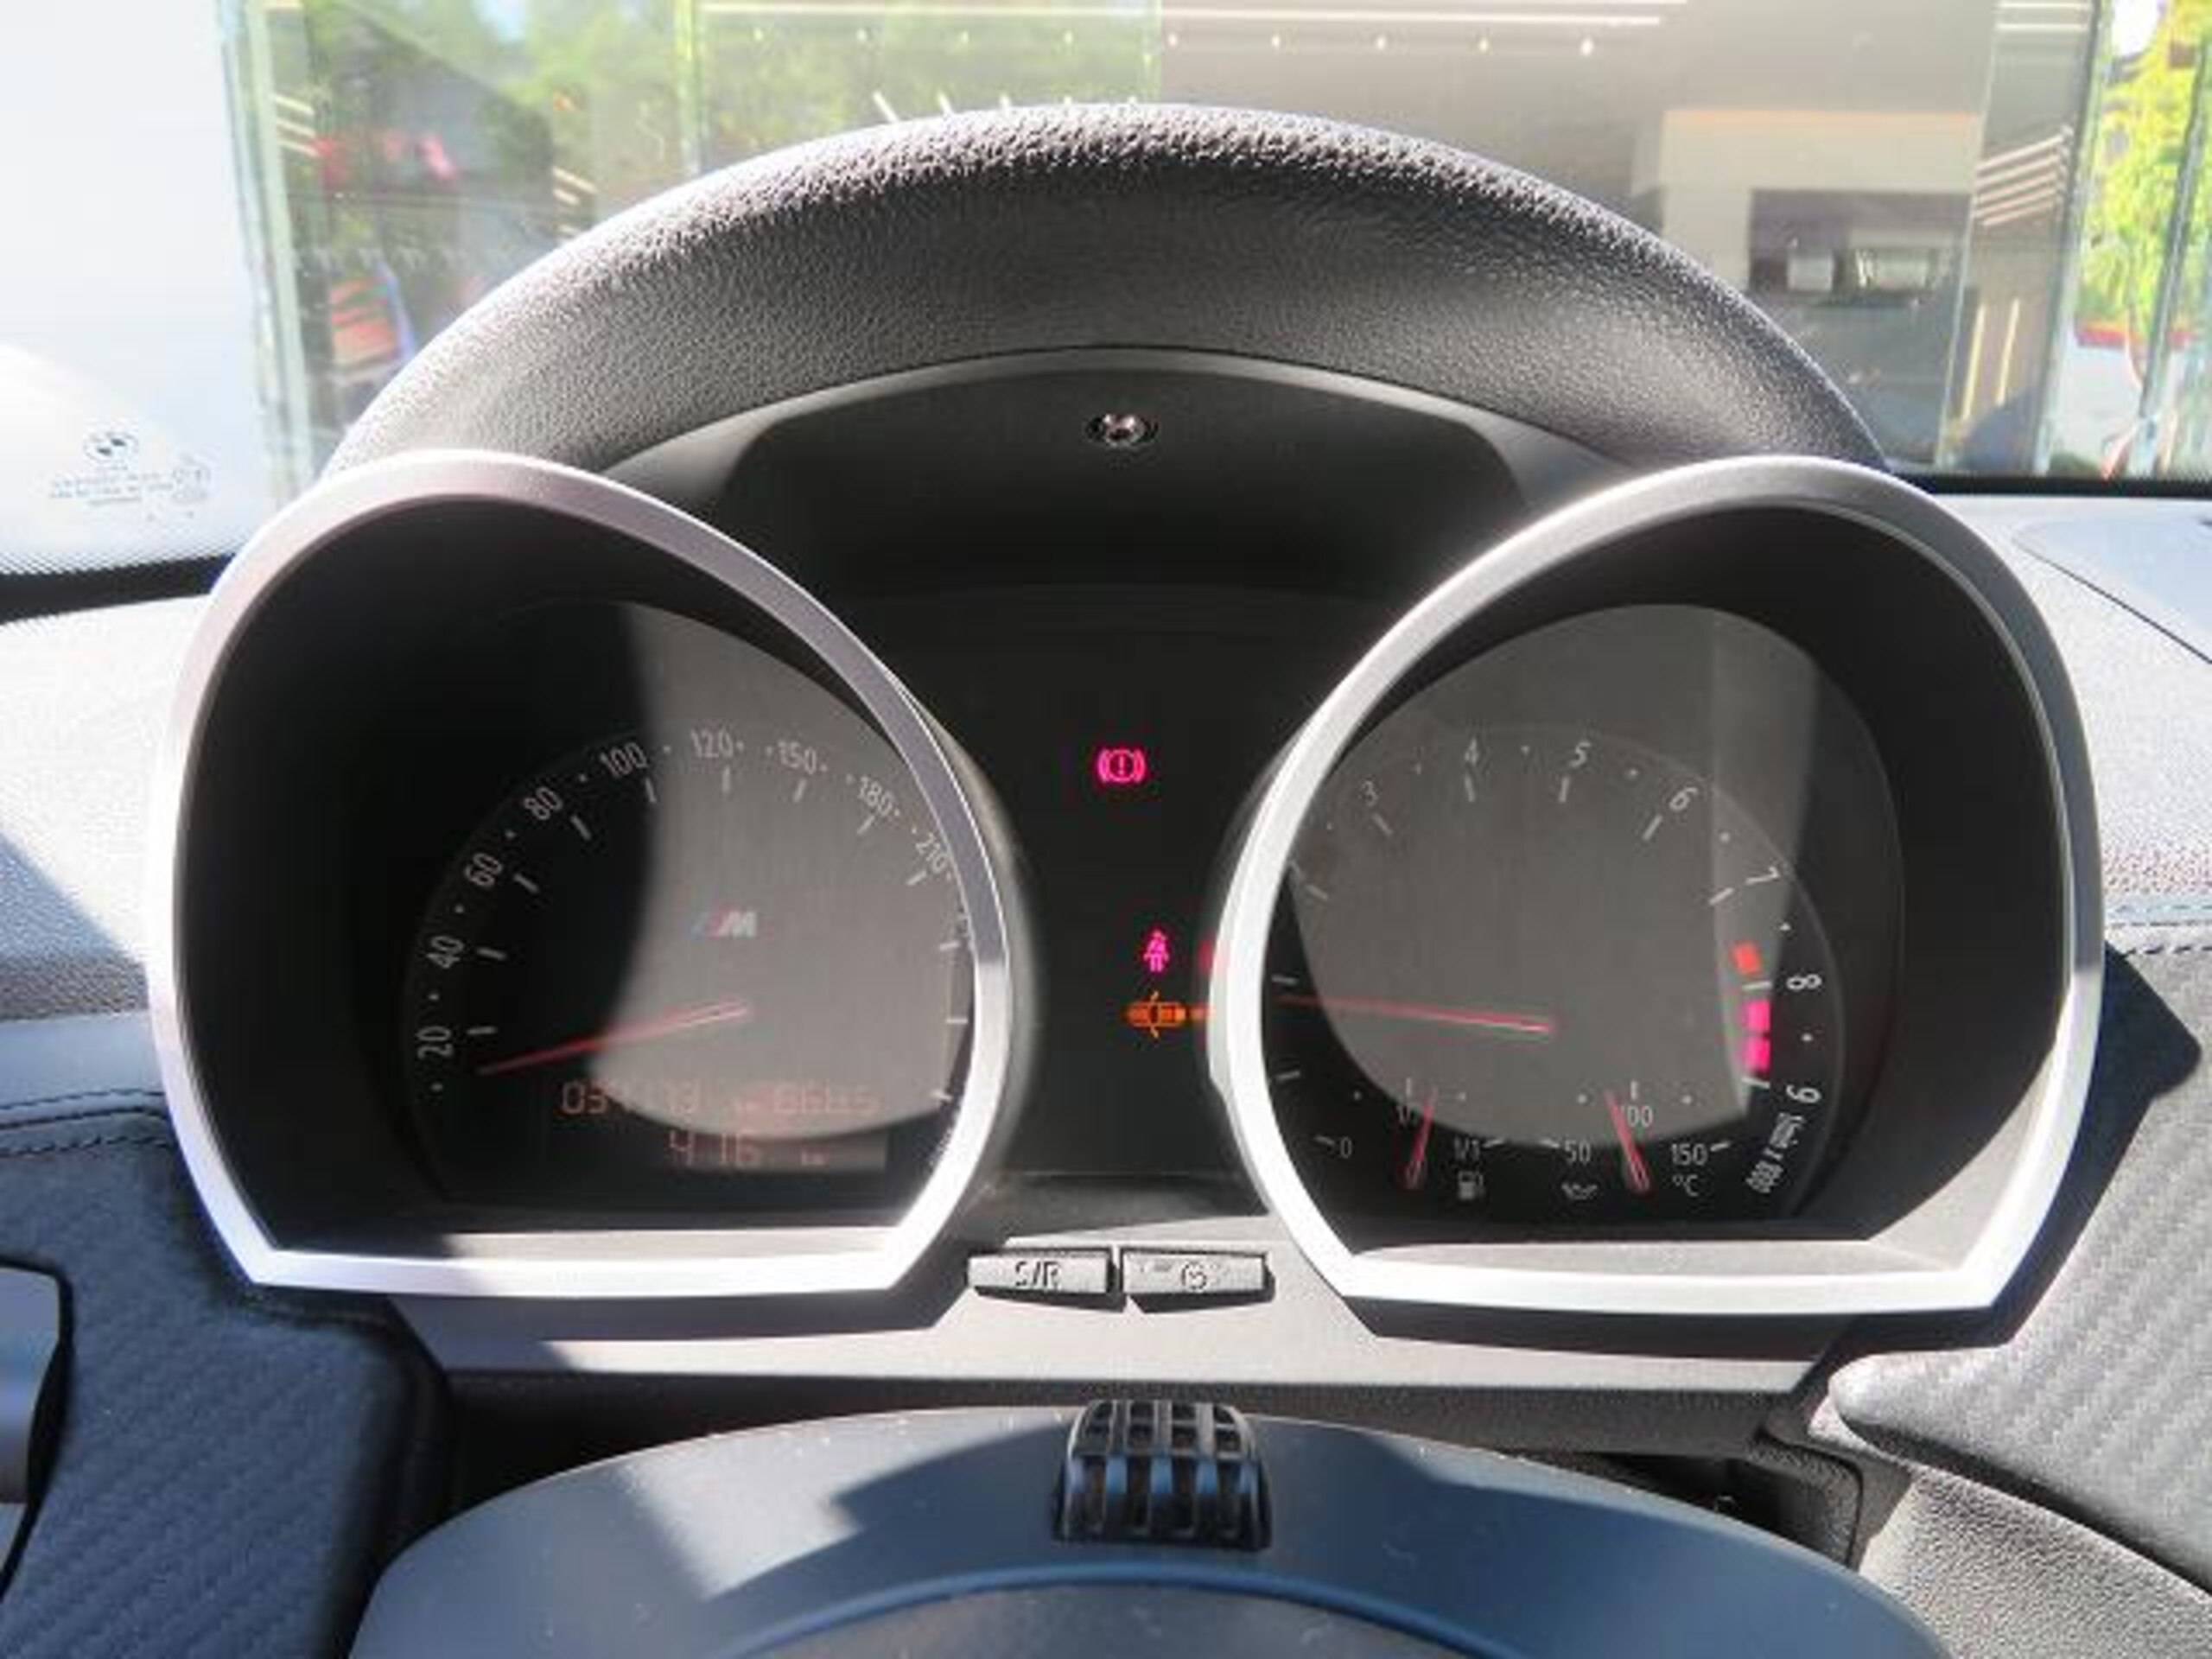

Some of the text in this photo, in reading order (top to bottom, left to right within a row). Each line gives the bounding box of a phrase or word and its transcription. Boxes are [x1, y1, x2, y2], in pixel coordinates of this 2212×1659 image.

[601, 741, 647, 776] 100
[690, 730, 734, 759] 120
[777, 740, 817, 775] 150
[1464, 738, 1479, 765] 4
[1568, 741, 1592, 768] 5
[523, 786, 563, 820] 80
[857, 776, 893, 817] 180
[1360, 780, 1379, 807] 3
[1669, 785, 1699, 811] 6
[914, 832, 950, 874] 210
[464, 852, 503, 887] 60
[1745, 865, 1781, 886] 7
[715, 910, 759, 938] M
[426, 935, 465, 969] 40
[1785, 973, 1822, 991] 8
[415, 1025, 454, 1058] 20
[1785, 1084, 1821, 1104] 9
[1339, 1136, 1353, 1160] 0
[1564, 1140, 1592, 1164] 50
[1671, 1142, 1708, 1166] 150
[1014, 1260, 1062, 1290] S/R
